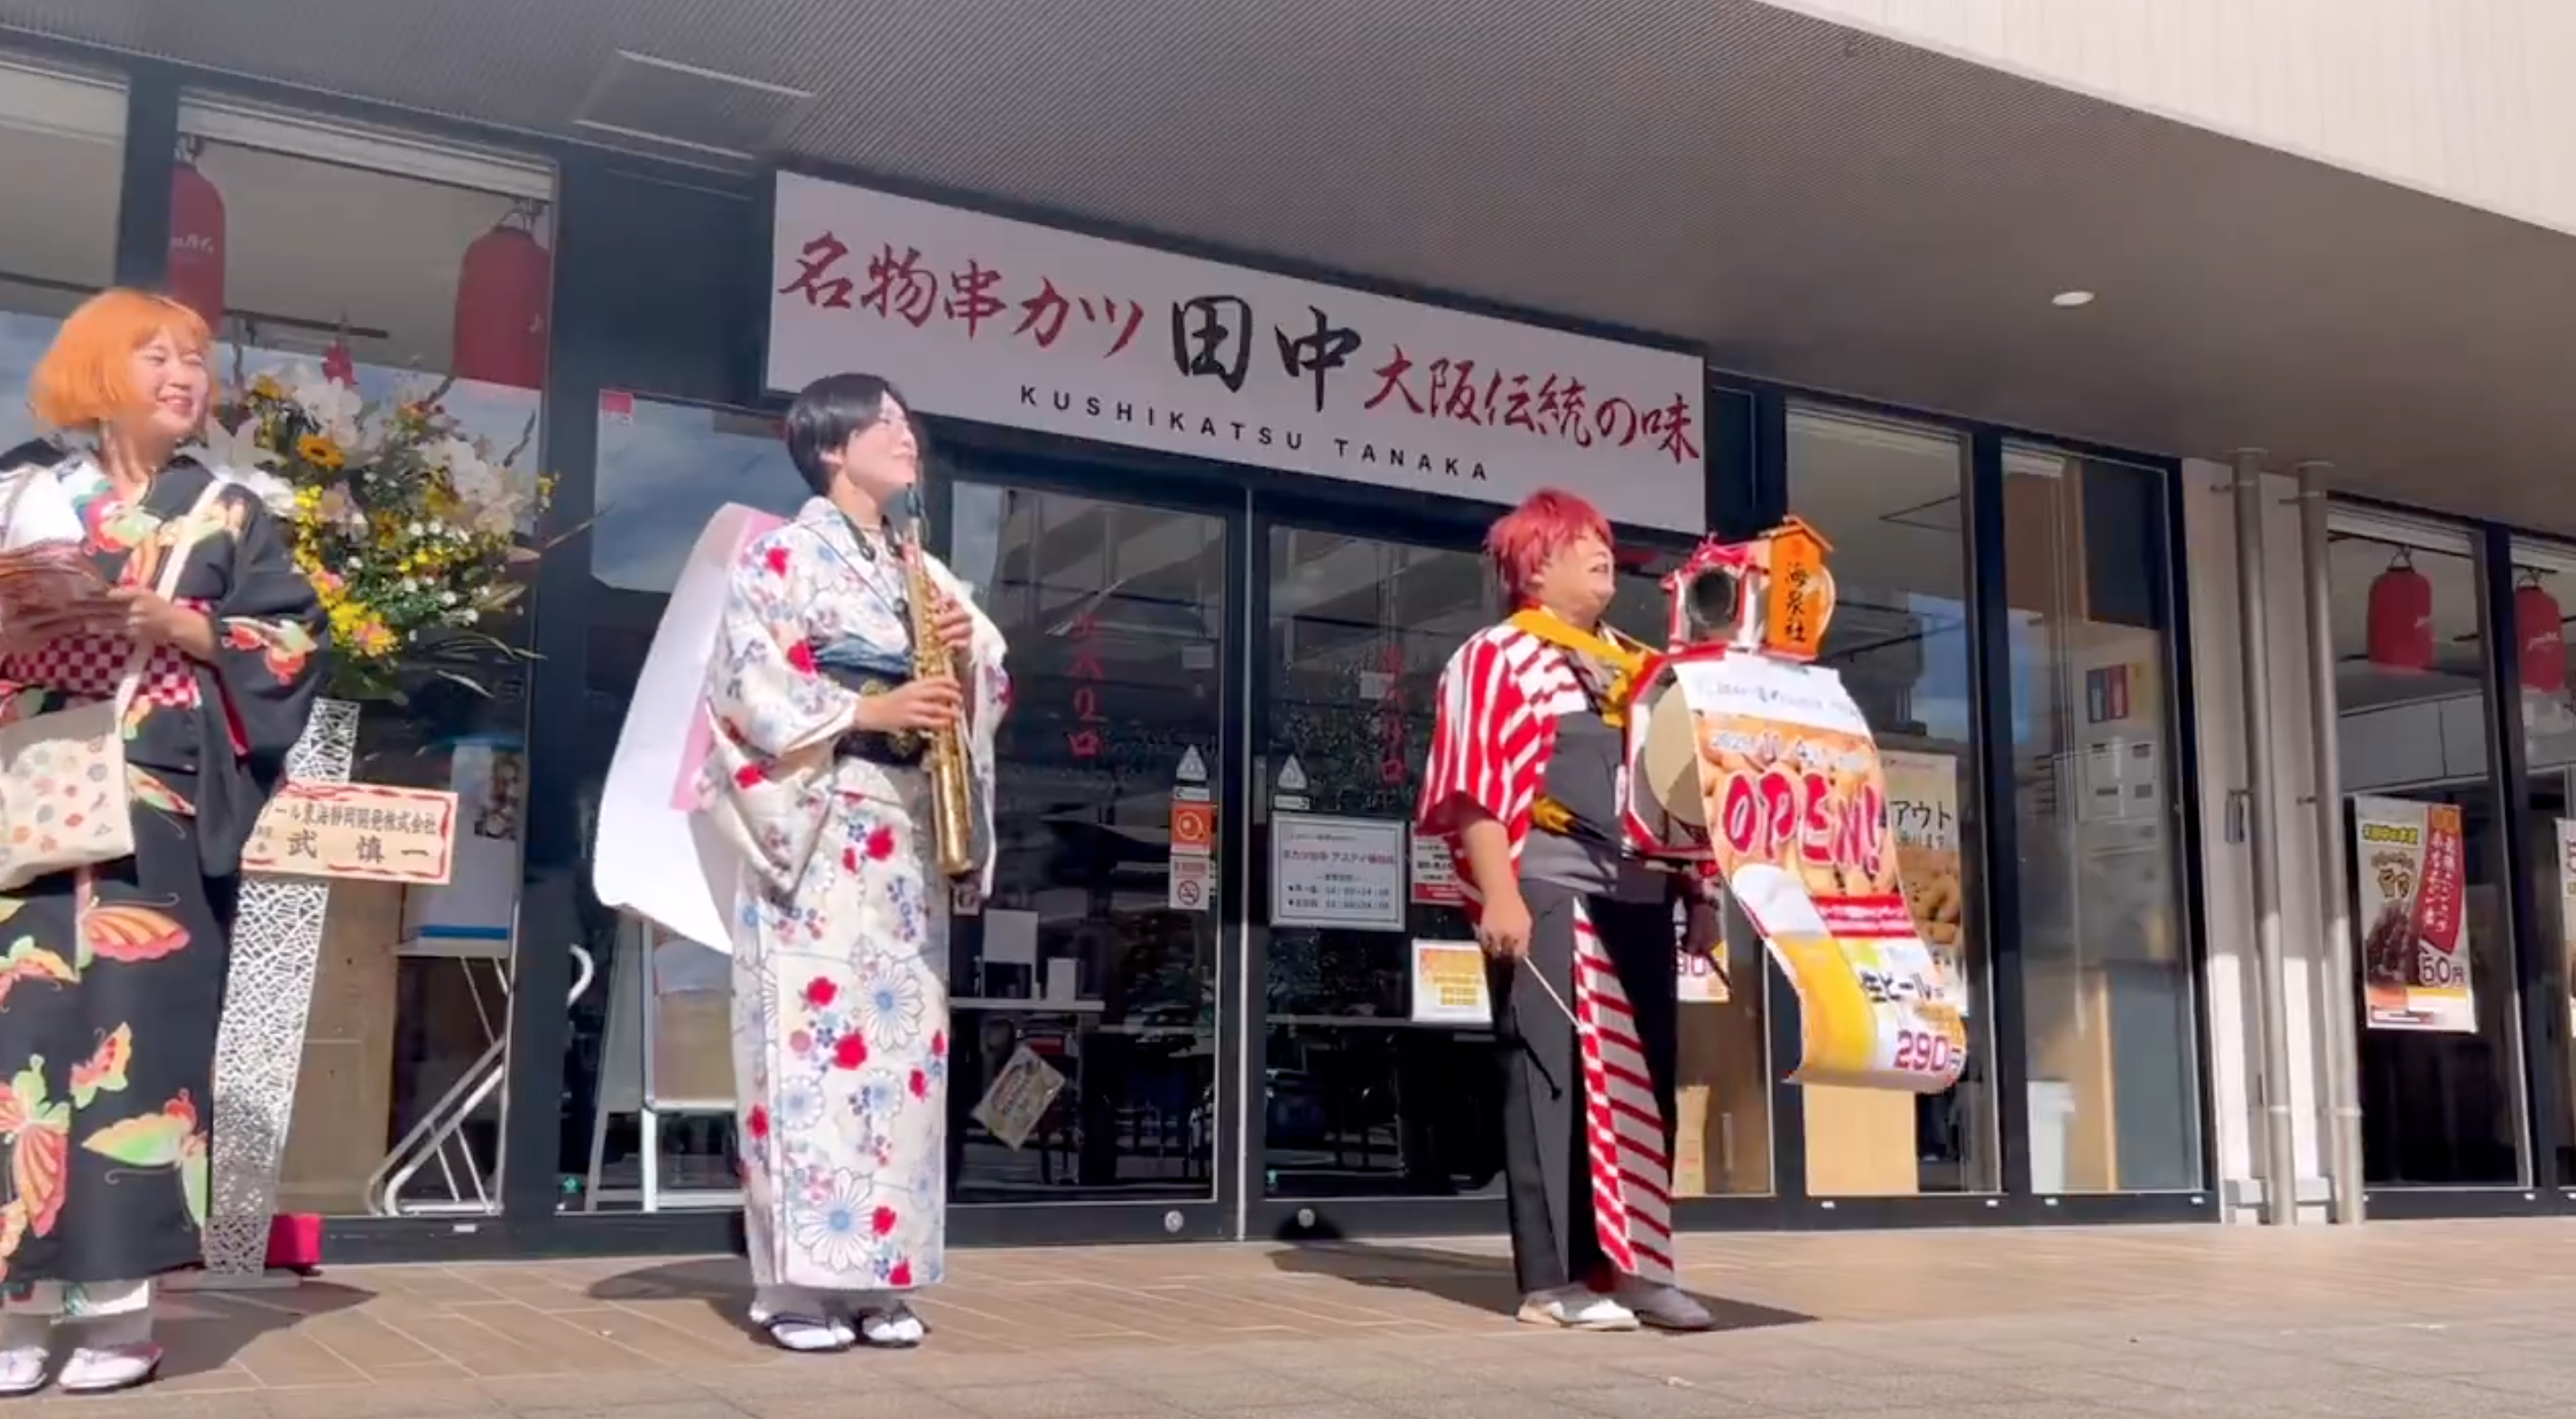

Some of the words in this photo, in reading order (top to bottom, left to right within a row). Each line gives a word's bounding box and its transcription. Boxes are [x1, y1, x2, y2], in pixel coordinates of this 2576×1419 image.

[778, 231, 1144, 359] 名物串カツ
[1172, 295, 1361, 413] 田中
[1364, 343, 1700, 465] 大阪伝統の味
[1020, 385, 1302, 450] KUSHIKATSU
[1335, 439, 1489, 481] TANAKA
[1722, 771, 1882, 874] OPEN!
